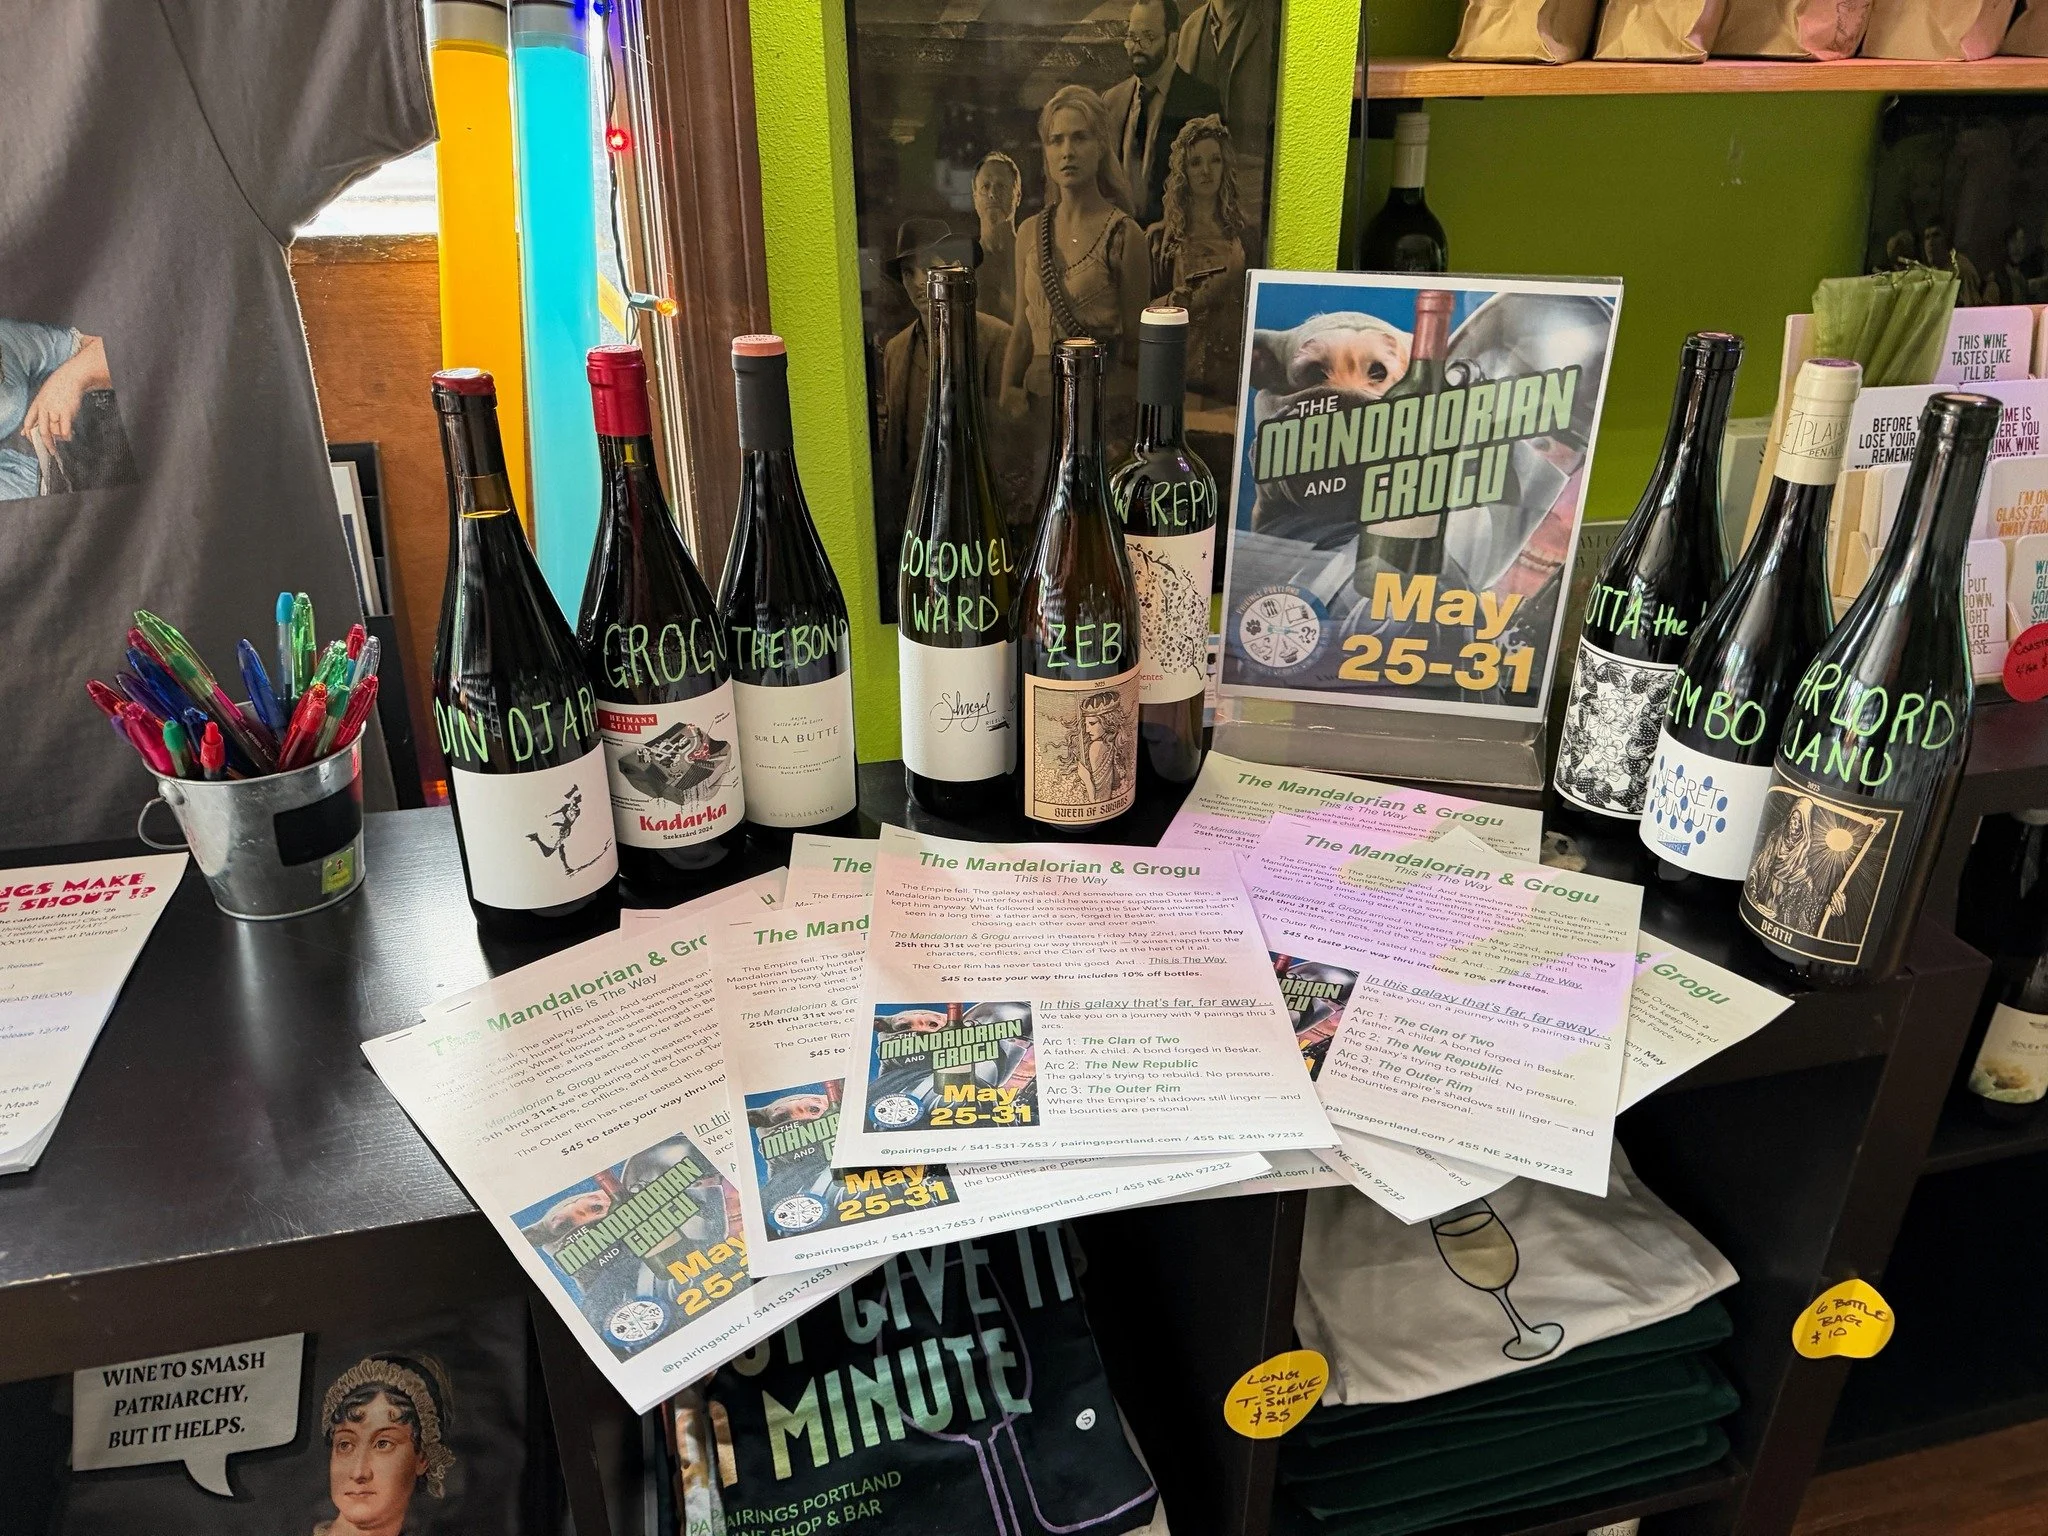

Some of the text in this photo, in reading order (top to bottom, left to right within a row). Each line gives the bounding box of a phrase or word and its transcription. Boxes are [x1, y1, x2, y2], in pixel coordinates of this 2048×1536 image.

[1958, 333, 2008, 350] THIS WINE
[1952, 349, 2012, 366] TASTES LIKE
[1963, 365, 1997, 380] I'LL BE
[1297, 395, 1339, 418] THE
[2022, 406, 2032, 421] IS
[1257, 369, 1580, 481] MANDALORIAN
[1872, 416, 1913, 432] BEFORE
[2022, 421, 2040, 436] YOU
[1859, 432, 1916, 449] LOSE YOUR
[2015, 436, 2040, 452] WINE
[1304, 477, 1347, 497] AND
[1360, 444, 1512, 523] GROGU
[1151, 478, 1218, 527] REPU
[1996, 505, 2045, 522] GLASS OF
[901, 529, 1015, 584] COLONEL
[913, 593, 999, 635] WARD
[1371, 573, 1526, 640] May
[1585, 582, 1689, 640] OTTA the
[603, 614, 728, 689] GROGU
[732, 614, 848, 671] THE BOND
[1046, 622, 1122, 669] ZEB
[1338, 634, 1535, 694] 25-31
[1667, 667, 1766, 746] EMBO
[1794, 659, 1955, 750] ARLORD
[435, 682, 600, 763] DIN DJARI
[609, 714, 656, 724] HEIMANN
[754, 725, 839, 744] SUR LA BUTTE
[1784, 719, 1893, 787] JANU
[639, 803, 727, 831] Kadarka
[1086, 806, 1098, 817] OF
[663, 825, 714, 840] Szekszárd 2024
[919, 851, 1201, 878] The Mandalorian & Grogu
[1304, 834, 1601, 904] The Mandalorian & Grogu
[62, 872, 147, 893] MAKE
[1014, 874, 1108, 886] This is The Way
[18, 890, 121, 911] SHOUT
[1760, 919, 1794, 945] DEATH
[977, 974, 1002, 982] taste
[1004, 975, 1028, 983] your
[1147, 970, 1162, 978] off
[1164, 970, 1202, 978] bottles.
[1652, 960, 1732, 1007] Grogu
[486, 951, 668, 1033] Mandalorian &
[1040, 1000, 1052, 1009] In
[1057, 1000, 1081, 1009] this
[1084, 998, 1129, 1010] galaxy
[1133, 998, 1169, 1008] that's
[1174, 997, 1194, 1007] far,
[1199, 997, 1217, 1007] far
[1042, 1037, 1063, 1046] Arc
[1081, 1036, 1104, 1045] The
[1108, 1036, 1136, 1045] Clan
[1139, 1036, 1152, 1044] of
[1156, 1036, 1180, 1044] Two
[904, 1054, 926, 1064] AND
[932, 1041, 999, 1070] GROGU
[1044, 1059, 1199, 1070] Arc 2: The New Republic
[943, 1084, 1020, 1106] May
[1046, 1084, 1181, 1095] Arc 3: The Outer Rim
[930, 1105, 1032, 1127] 25-31
[881, 1145, 958, 1156] @pairingspdx
[970, 1141, 1049, 1150] 541-531-7653
[1061, 1136, 1181, 1148] pairingsportland.com
[1238, 1132, 1264, 1140] 24th
[1267, 1130, 1305, 1139] 97232
[844, 1164, 926, 1196] May
[838, 1181, 950, 1222] 25-31
[1816, 1299, 1888, 1322] 6 BOTTLE
[102, 1351, 267, 1388] WINE TO SMASH
[1247, 1370, 1300, 1385] LONG
[113, 1384, 249, 1418] PATRIARCHY,
[761, 1327, 1033, 1481] MINUTE
[1249, 1407, 1291, 1426] $35
[108, 1417, 246, 1449] BUT IT HELPS.
[802, 1471, 901, 1514] PORTLAND
[826, 1510, 841, 1526] &
[844, 1499, 882, 1523] BAR
